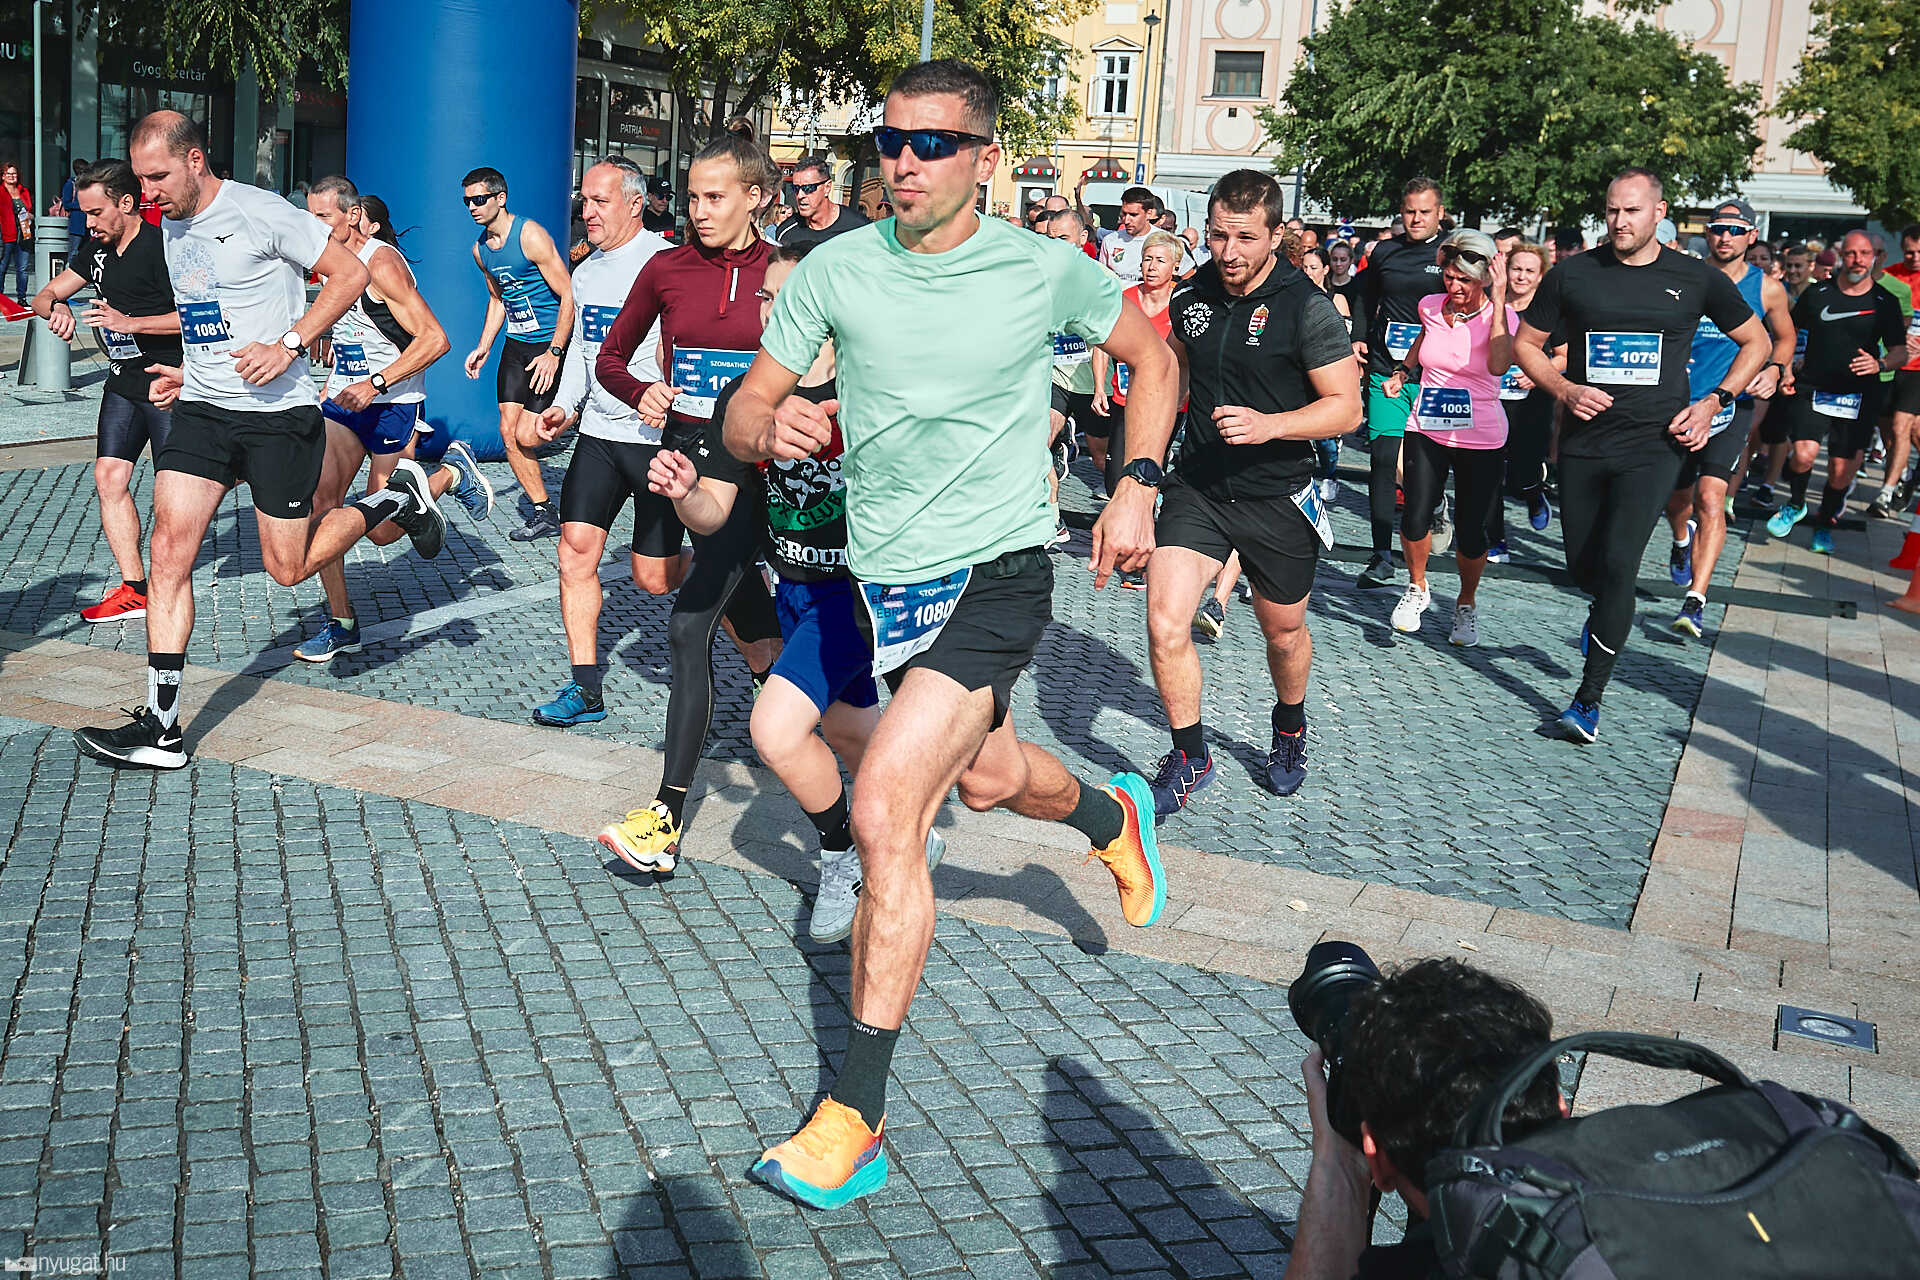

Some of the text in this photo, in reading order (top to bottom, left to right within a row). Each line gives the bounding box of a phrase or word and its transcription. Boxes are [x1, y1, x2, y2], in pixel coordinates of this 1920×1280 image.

[193, 321, 226, 338] 1081
[1063, 341, 1086, 351] 1108
[1619, 351, 1659, 364] 1079
[1440, 402, 1472, 414] 1003
[796, 493, 842, 527] CLUB
[914, 598, 956, 628] 1080
